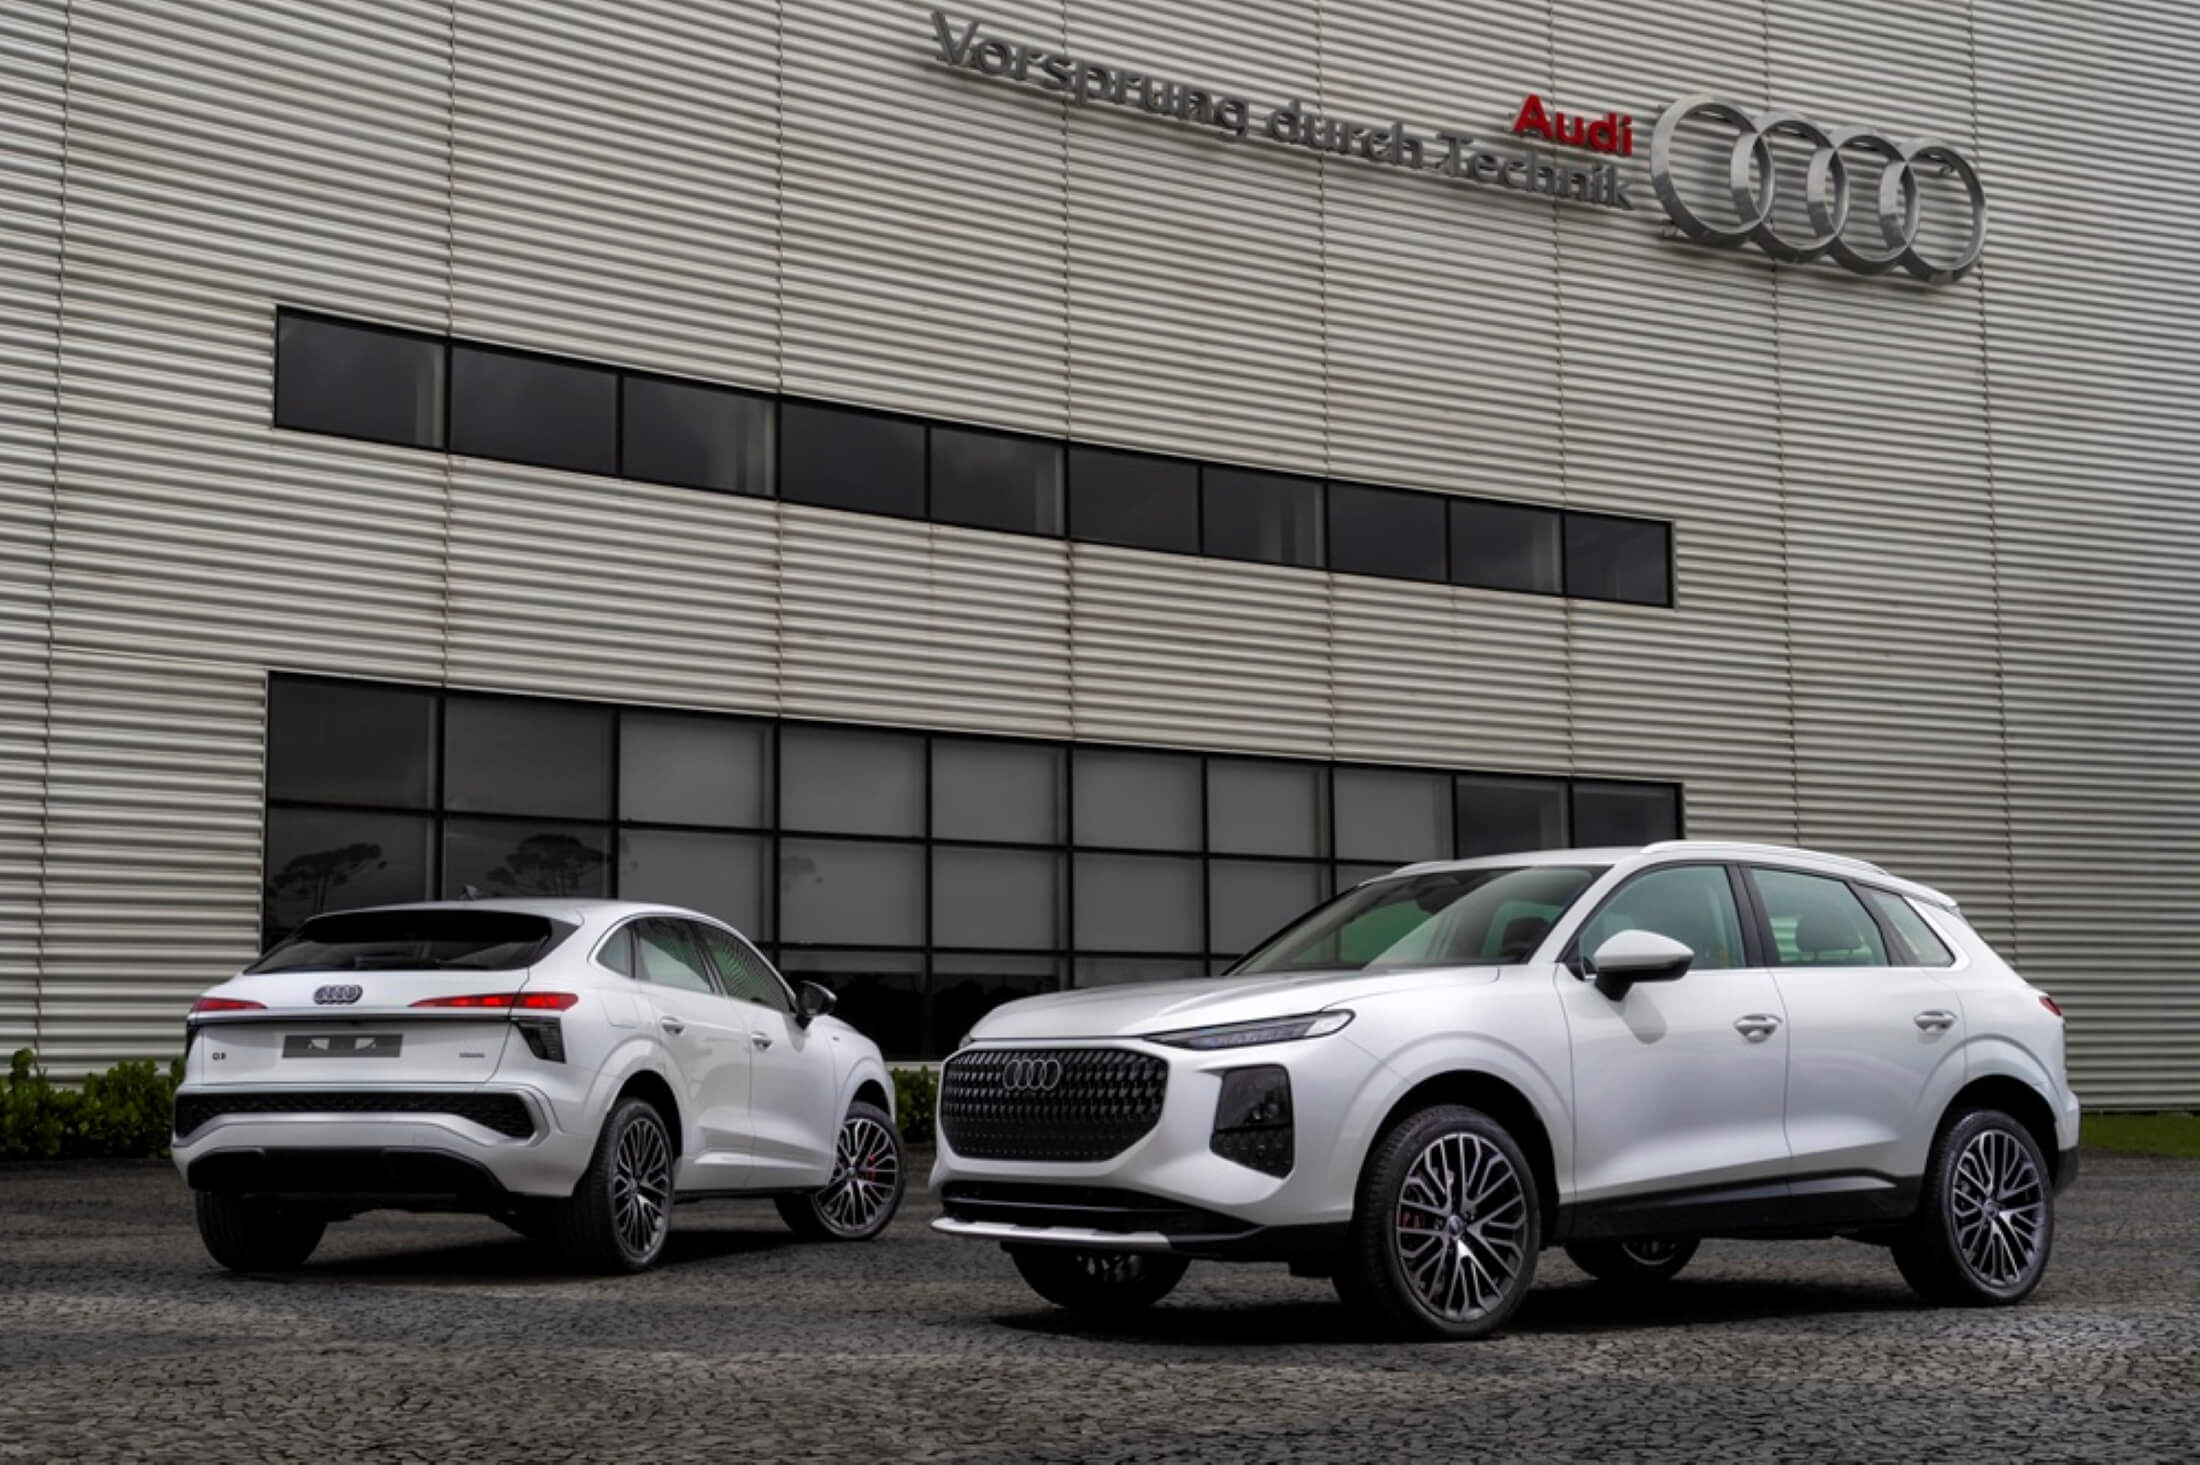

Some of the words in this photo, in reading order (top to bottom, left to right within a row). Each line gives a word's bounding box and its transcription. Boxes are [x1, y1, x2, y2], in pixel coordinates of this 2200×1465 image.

[931, 10, 1249, 137] Vorsprung
[1268, 98, 1424, 170] durch
[1437, 131, 1633, 211] Technik
[1513, 93, 1633, 157] Audi
